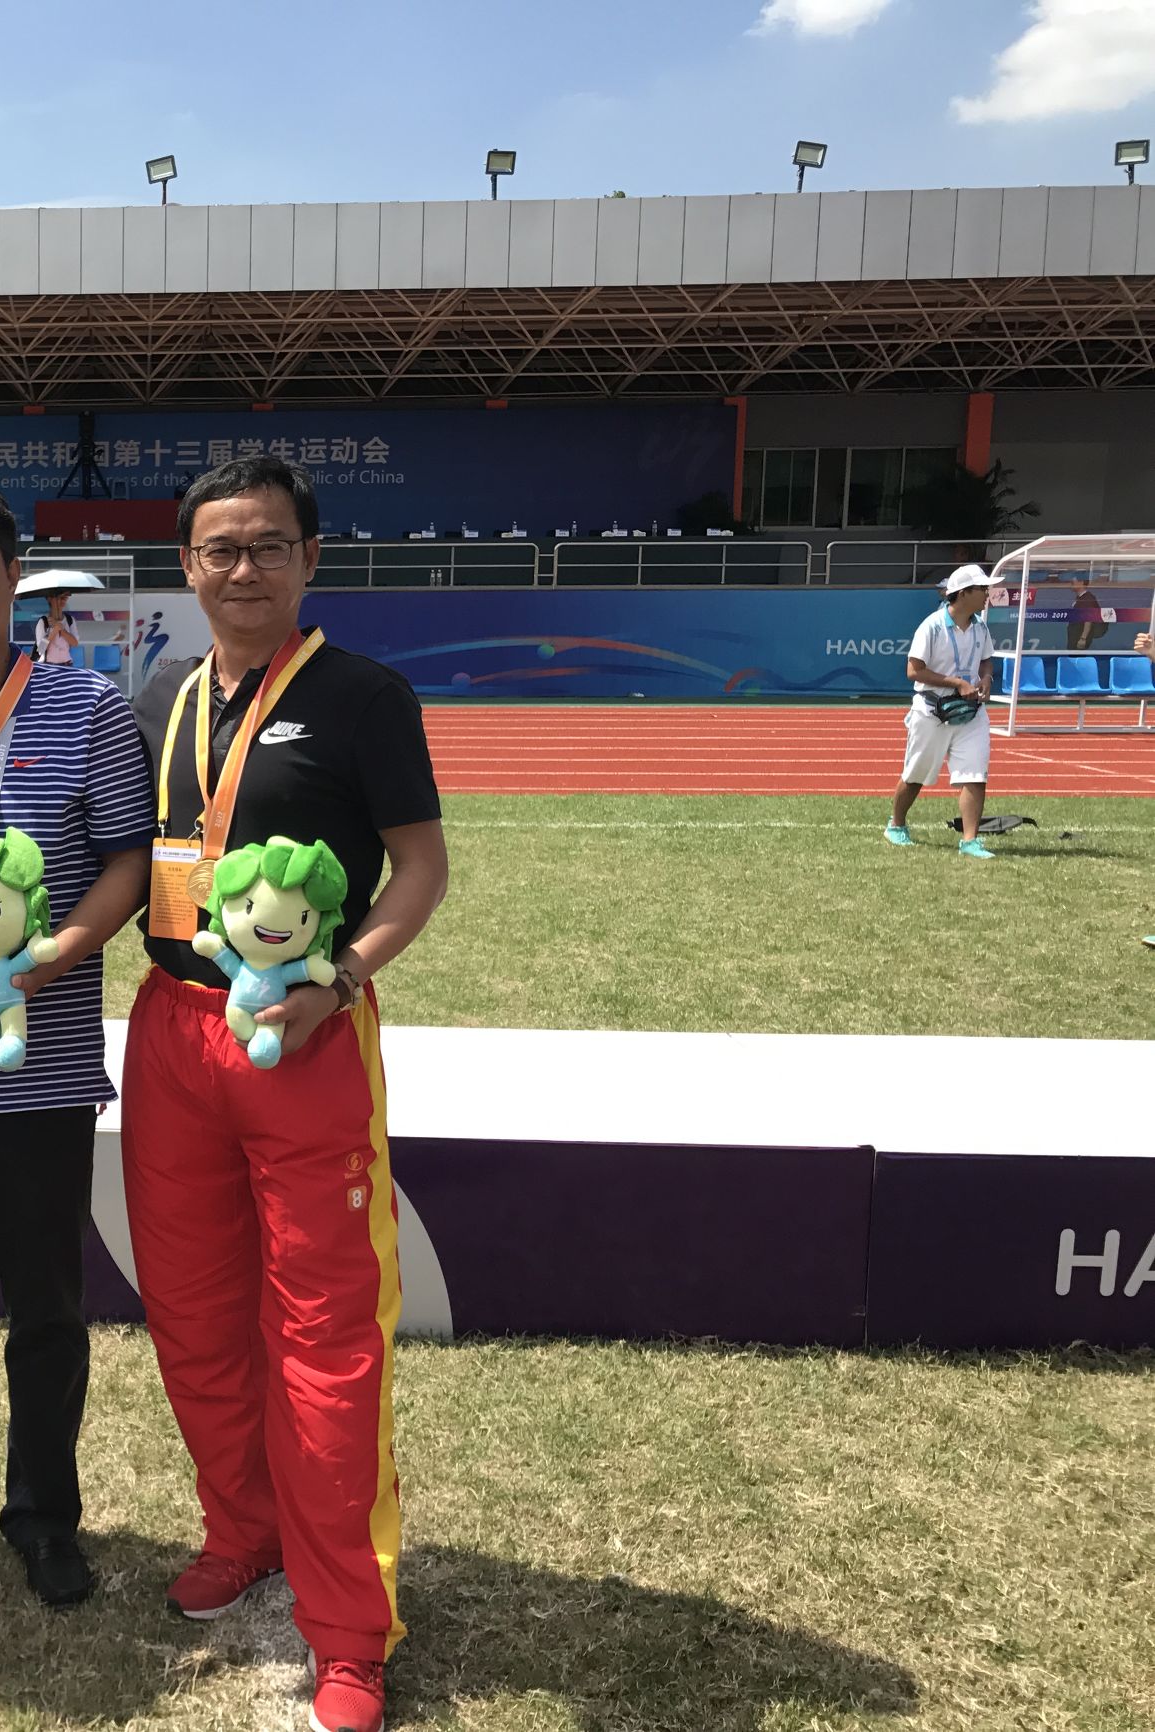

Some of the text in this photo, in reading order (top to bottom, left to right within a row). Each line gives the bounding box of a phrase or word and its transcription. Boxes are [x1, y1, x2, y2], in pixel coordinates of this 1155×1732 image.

[142, 472, 159, 486] of
[338, 470, 356, 485] of
[359, 469, 405, 485] China
[1010, 612, 1048, 620] HAGZHOU
[826, 639, 909, 656] HANGZ
[268, 720, 306, 737] NIKE
[352, 1189, 362, 1208] 8
